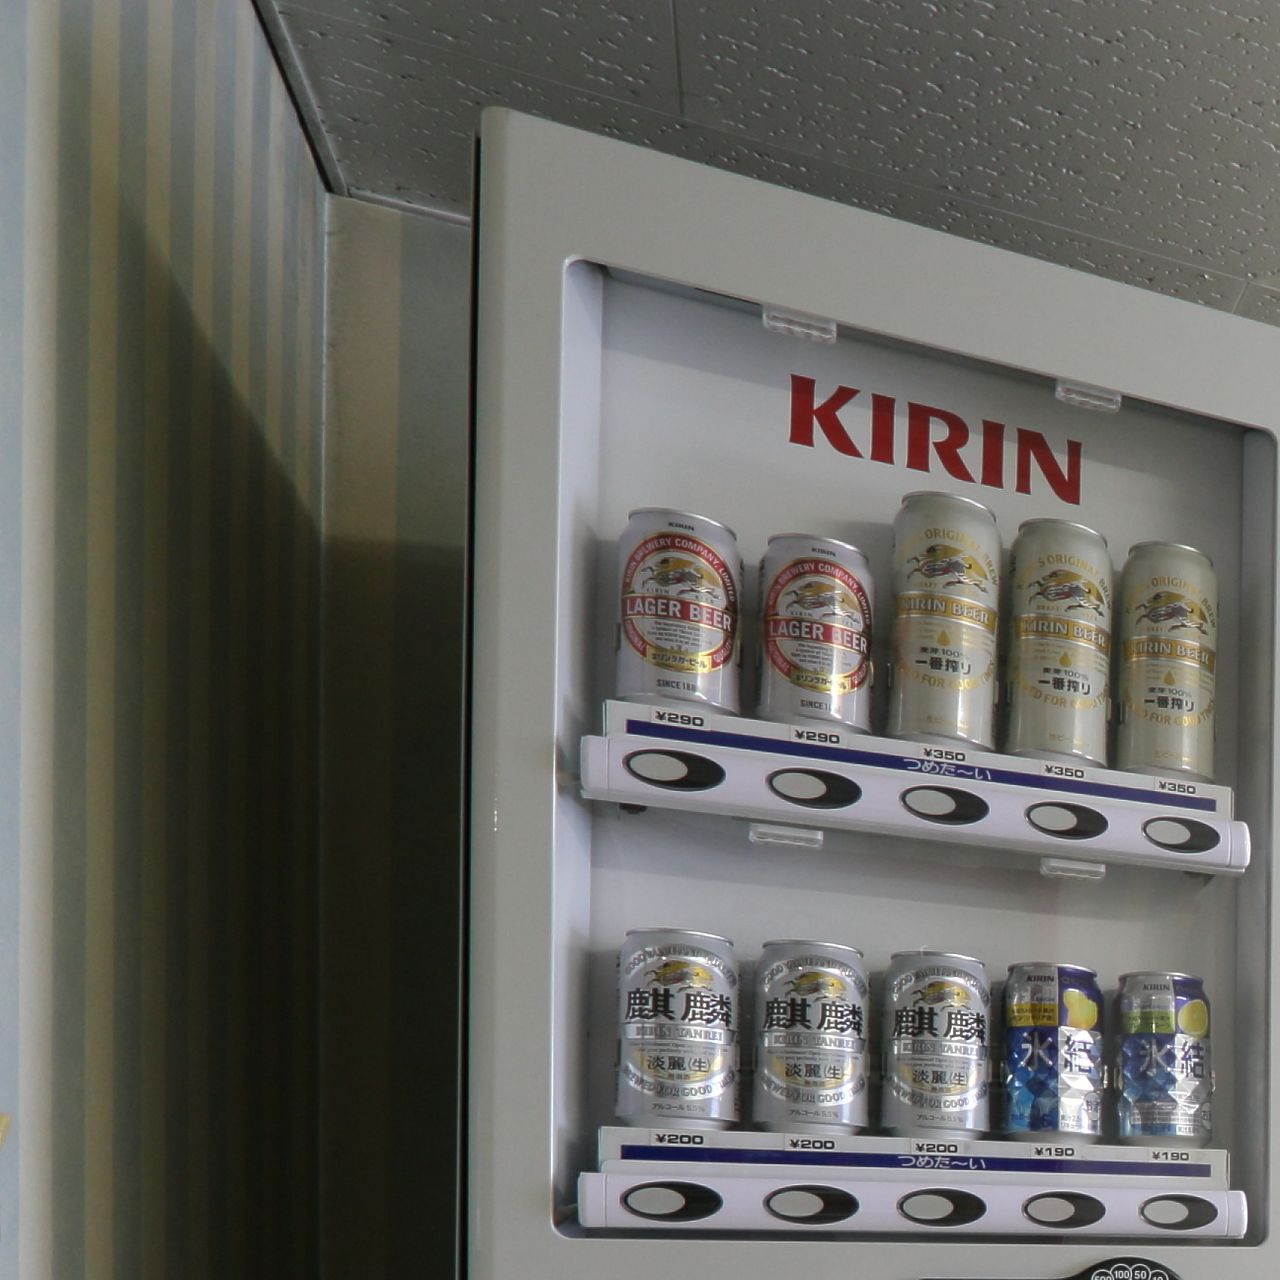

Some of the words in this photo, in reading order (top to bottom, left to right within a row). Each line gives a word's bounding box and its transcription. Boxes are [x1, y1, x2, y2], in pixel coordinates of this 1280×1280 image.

[789, 373, 1082, 505] KIRIN
[668, 522, 695, 531] KIRIN
[811, 547, 836, 557] KIRIN
[626, 598, 682, 617] LAGER
[689, 603, 732, 632] BEER
[902, 598, 947, 613] KIRIN
[951, 602, 990, 625] BEER
[769, 620, 824, 641] LAGER
[832, 626, 868, 654] BEER
[1022, 620, 1069, 635] KIRIN
[1072, 626, 1106, 647] BEER
[1176, 645, 1209, 665] BEER
[915, 657, 972, 676] 一番搾り
[656, 679, 681, 690] SINCE
[796, 673, 848, 690] キリンラガール
[1038, 677, 1091, 696] 一番搾り
[800, 699, 823, 710] SINCE
[1144, 695, 1194, 712] 一番搾り
[655, 710, 705, 727] ¥290
[794, 729, 841, 745] ¥290
[922, 747, 966, 763] ¥350
[1044, 764, 1085, 779] ¥350
[1158, 781, 1197, 795] ¥350
[1026, 975, 1055, 983] KIRIN
[1142, 984, 1171, 992] KIRIN
[625, 987, 732, 1027] 麒麟
[763, 997, 866, 1037] 麒麟
[893, 1006, 987, 1046] 麒麟
[1020, 1030, 1095, 1073] 氷結
[1139, 1038, 1205, 1079] 氷結
[655, 1133, 704, 1146] ¥200
[788, 1139, 836, 1151] ¥200
[915, 1143, 959, 1155] ¥200
[1034, 1146, 1076, 1158] ¥190
[1152, 1150, 1190, 1162] ¥190
[1114, 1270, 1130, 1279] 100
[1134, 1270, 1147, 1279] 50
